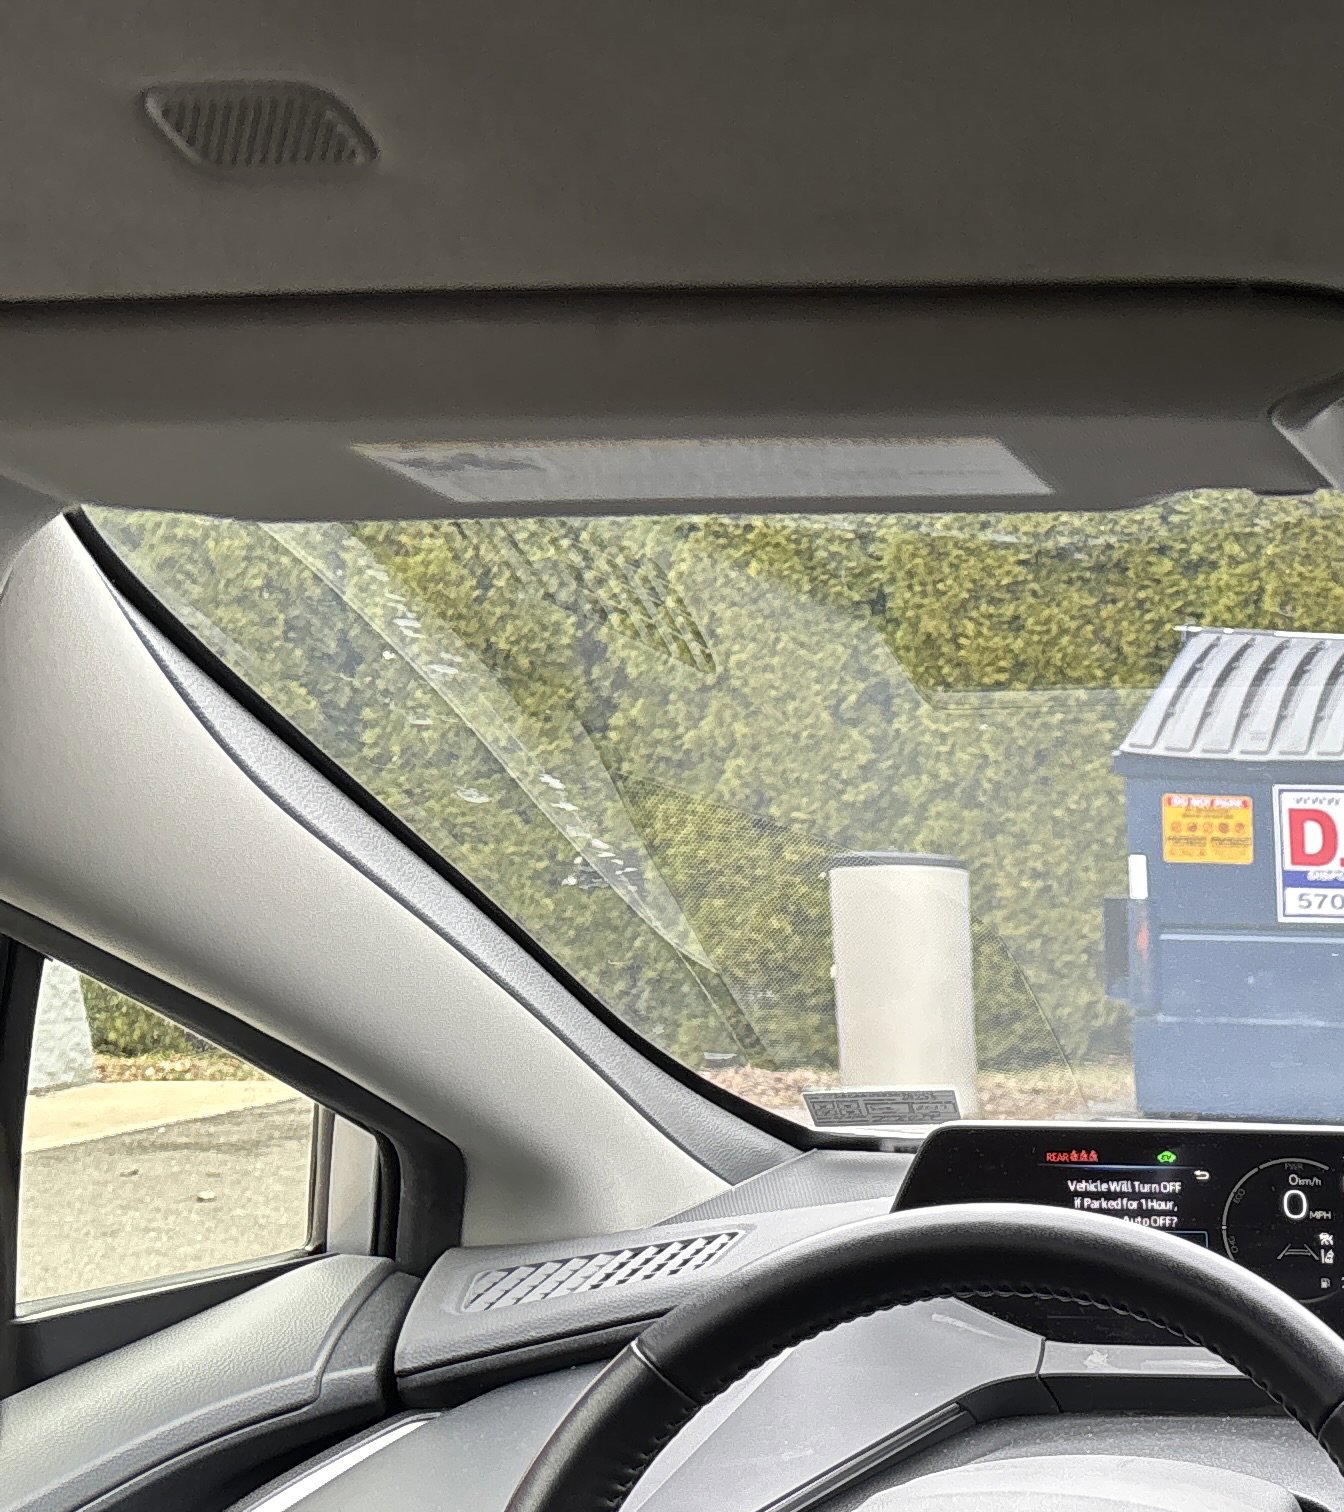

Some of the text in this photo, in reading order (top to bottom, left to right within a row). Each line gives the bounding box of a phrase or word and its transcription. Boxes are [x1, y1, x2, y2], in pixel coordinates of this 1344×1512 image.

[1046, 1152, 1070, 1162] REAR
[1067, 1180, 1182, 1193] Vehicle Will Turn OFF
[1083, 1197, 1122, 1209] Parked
[1122, 1197, 1139, 1210] for
[1147, 1198, 1178, 1211] Hour,
[1283, 1189, 1308, 1220] 0
[1309, 1210, 1332, 1220] MPH
[1150, 1216, 1178, 1228] OFF?
